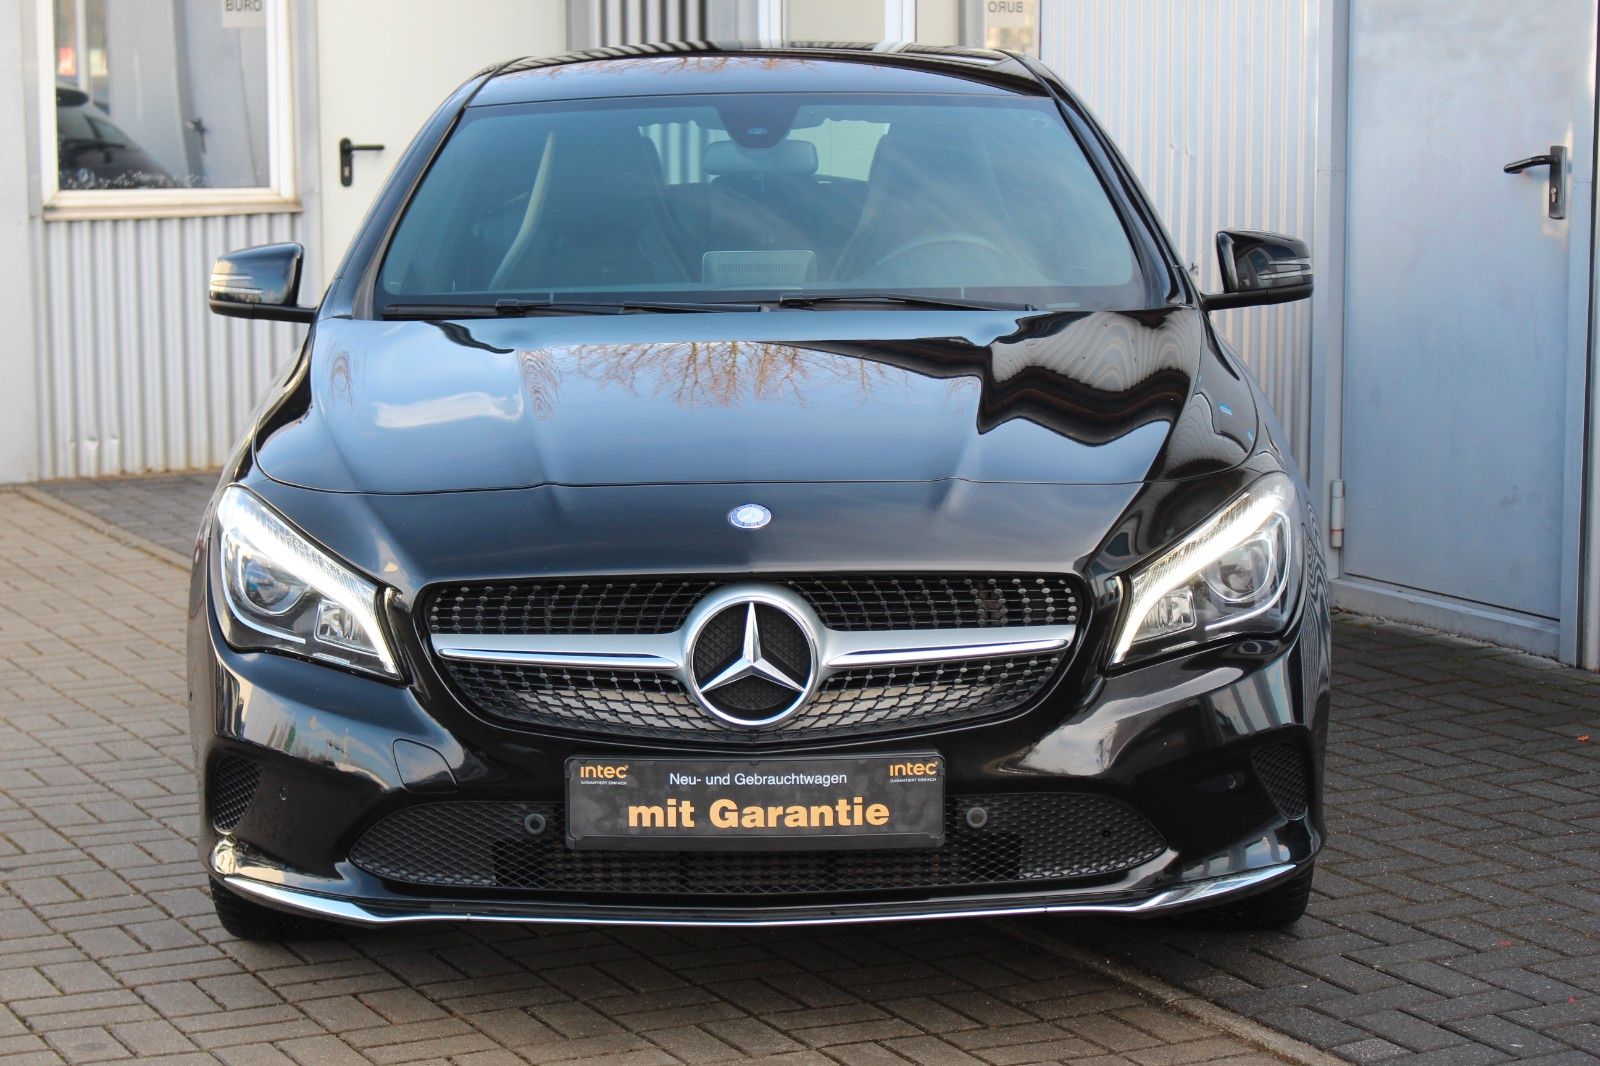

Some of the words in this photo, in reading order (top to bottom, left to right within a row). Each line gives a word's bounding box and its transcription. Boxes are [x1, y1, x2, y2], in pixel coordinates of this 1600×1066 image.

[580, 765, 627, 778] intec
[890, 762, 937, 776] intec
[669, 773, 701, 785] Neu-
[705, 773, 731, 785] und
[734, 773, 847, 787] Gebrauchtwagen
[628, 798, 695, 828] mit
[709, 796, 890, 829] Garantie
